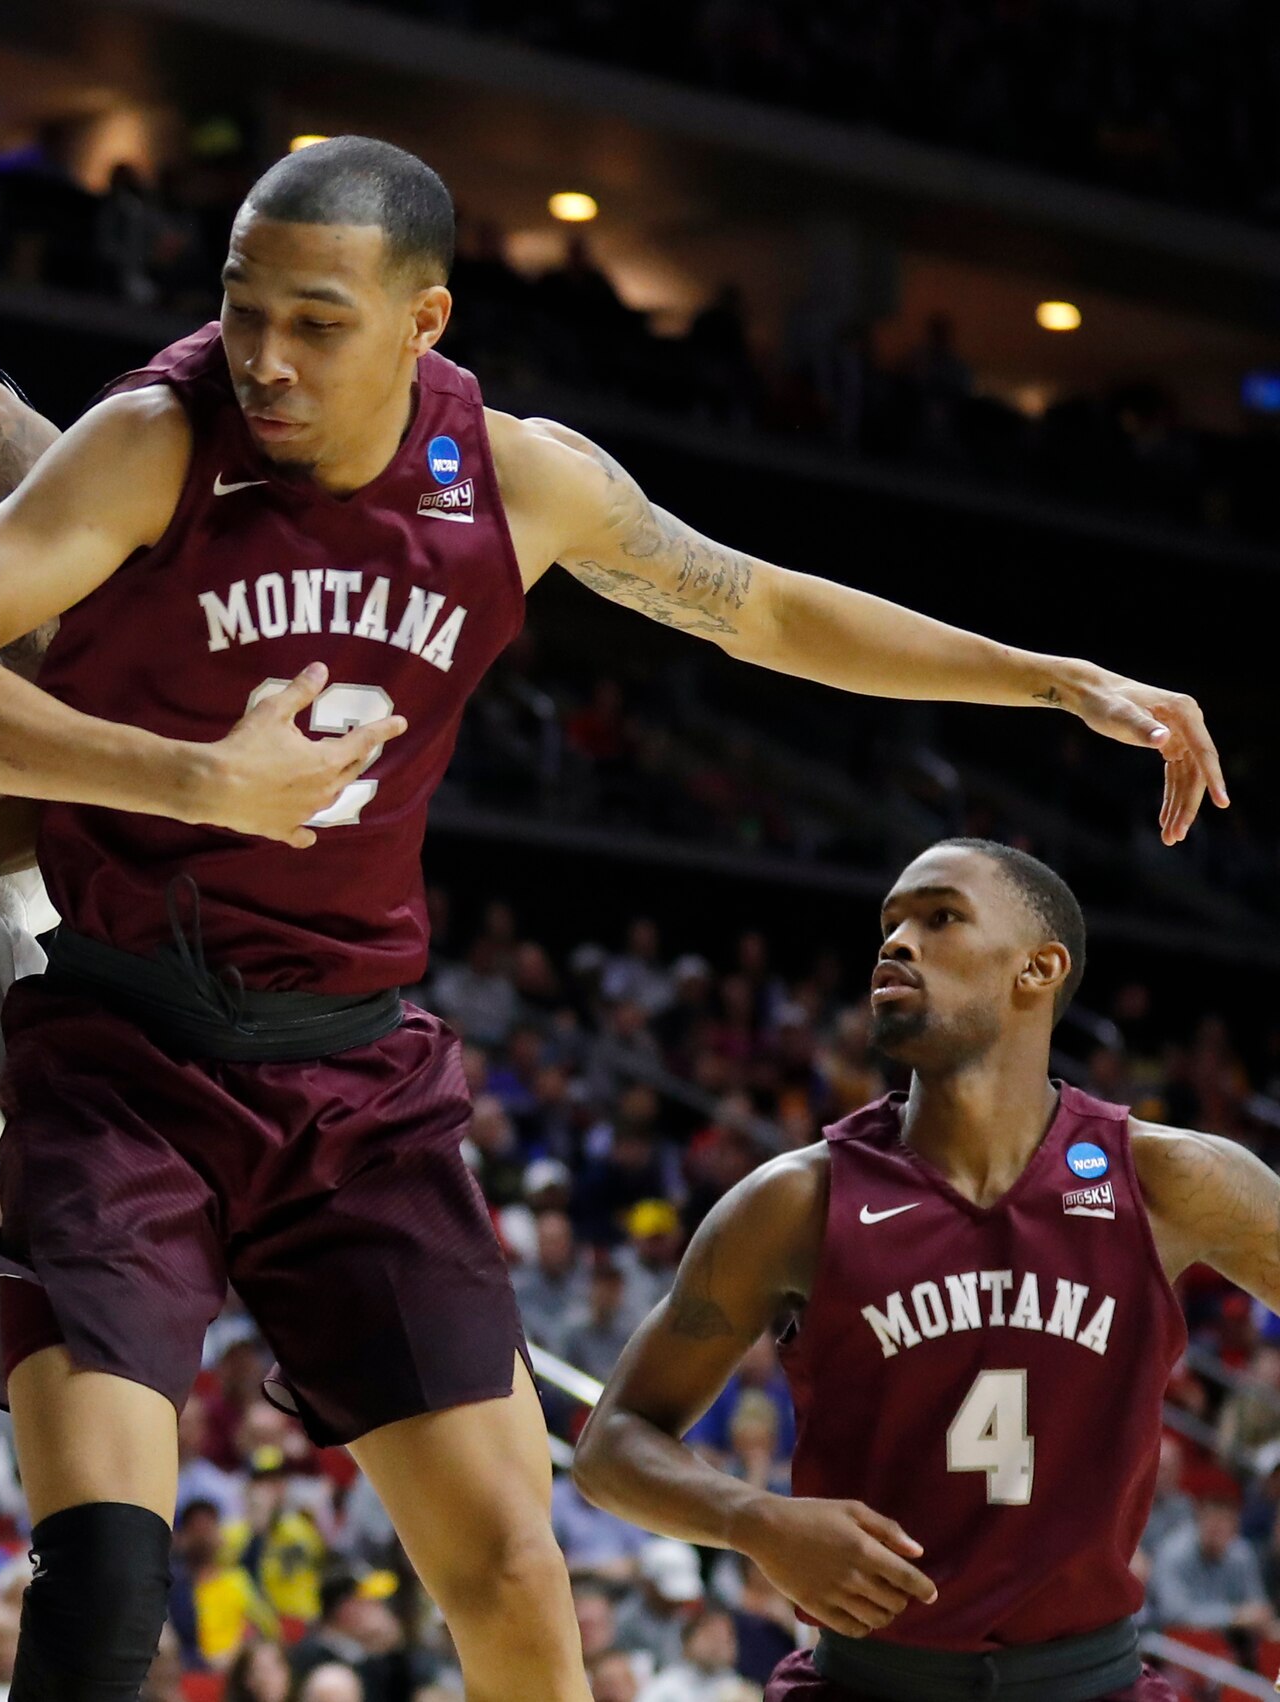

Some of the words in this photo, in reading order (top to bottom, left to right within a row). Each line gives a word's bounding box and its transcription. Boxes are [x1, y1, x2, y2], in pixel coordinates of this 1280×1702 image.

[432, 458, 458, 473] NCAA
[198, 568, 468, 673] MONTANA
[245, 677, 395, 827] 2
[1073, 1156, 1107, 1171] NCAA
[860, 1269, 1117, 1359] MONTANA
[946, 1368, 1035, 1506] 4
